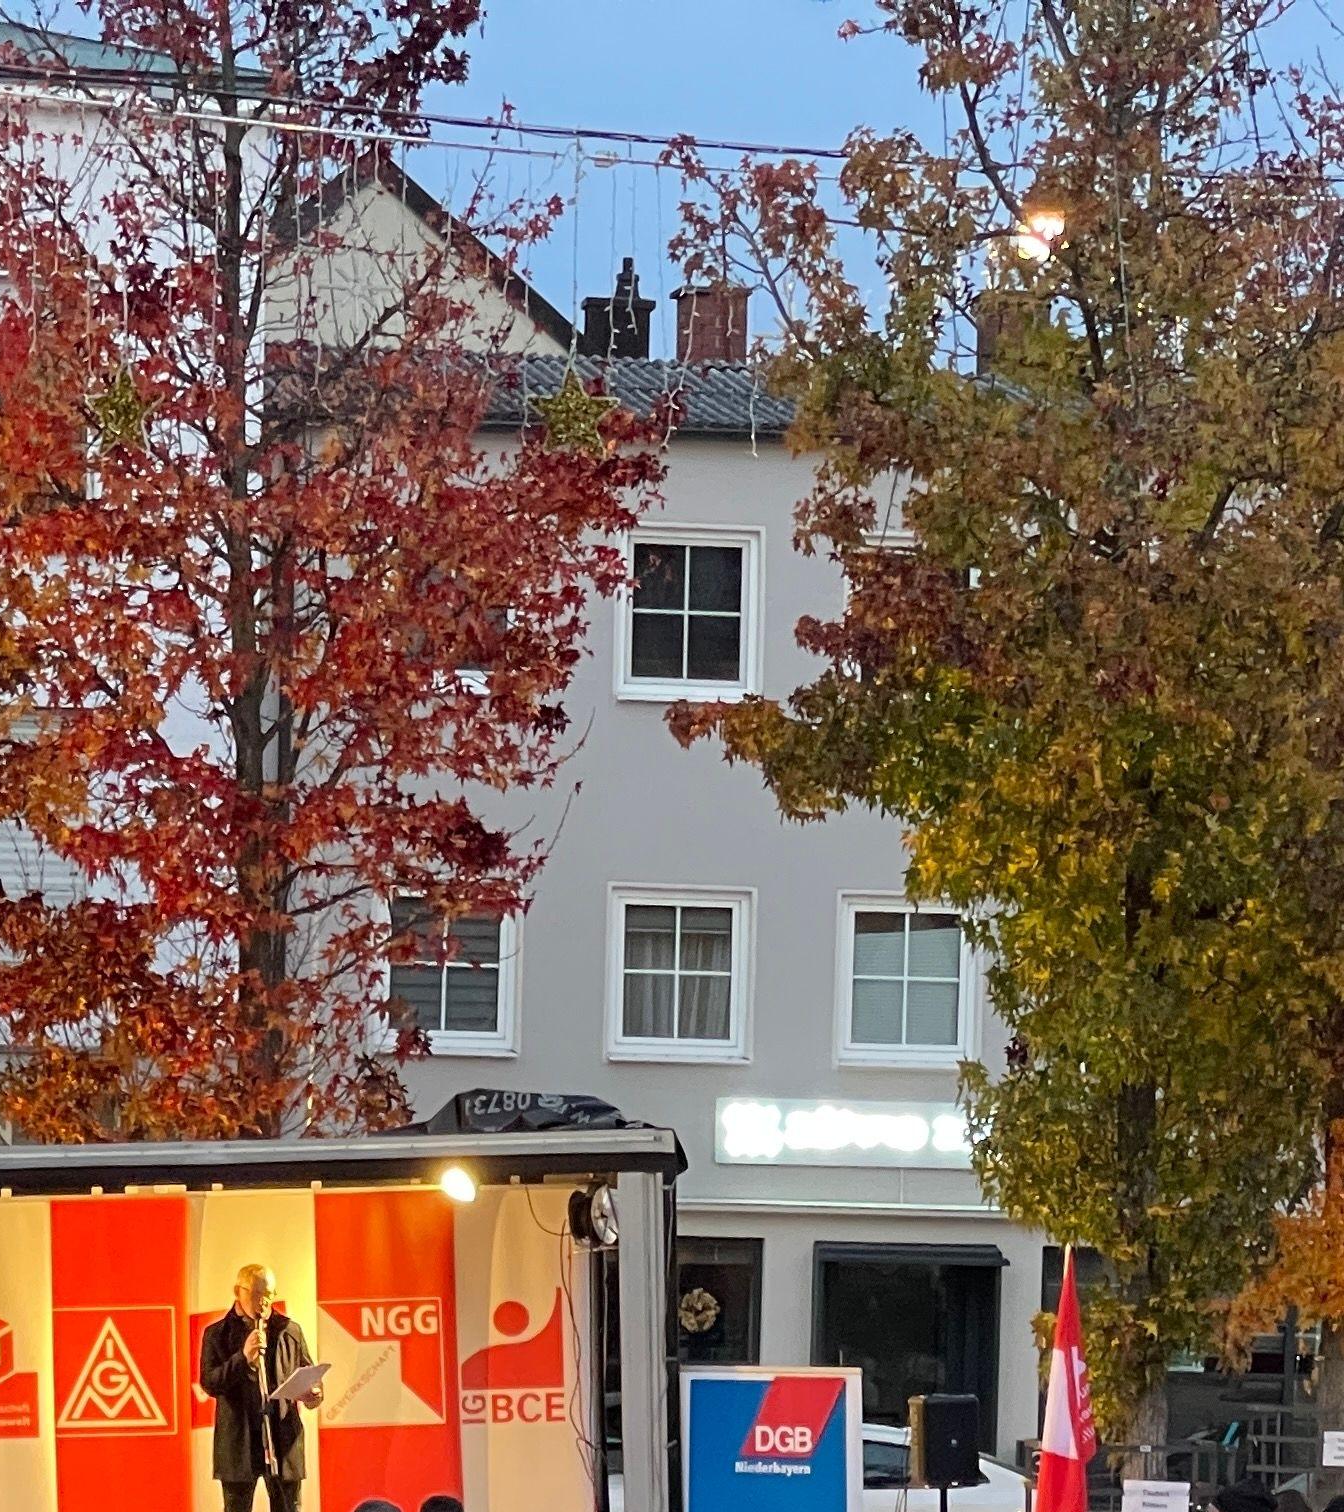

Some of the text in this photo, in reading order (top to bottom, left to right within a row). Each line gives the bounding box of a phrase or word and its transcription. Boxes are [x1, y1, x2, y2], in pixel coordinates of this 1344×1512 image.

[360, 1304, 439, 1336] NGG
[326, 1345, 397, 1421] GEWERKSCHAFT
[462, 1393, 566, 1424] IG BCE
[755, 1425, 813, 1453] DGB
[735, 1461, 811, 1477] Niederbayern
